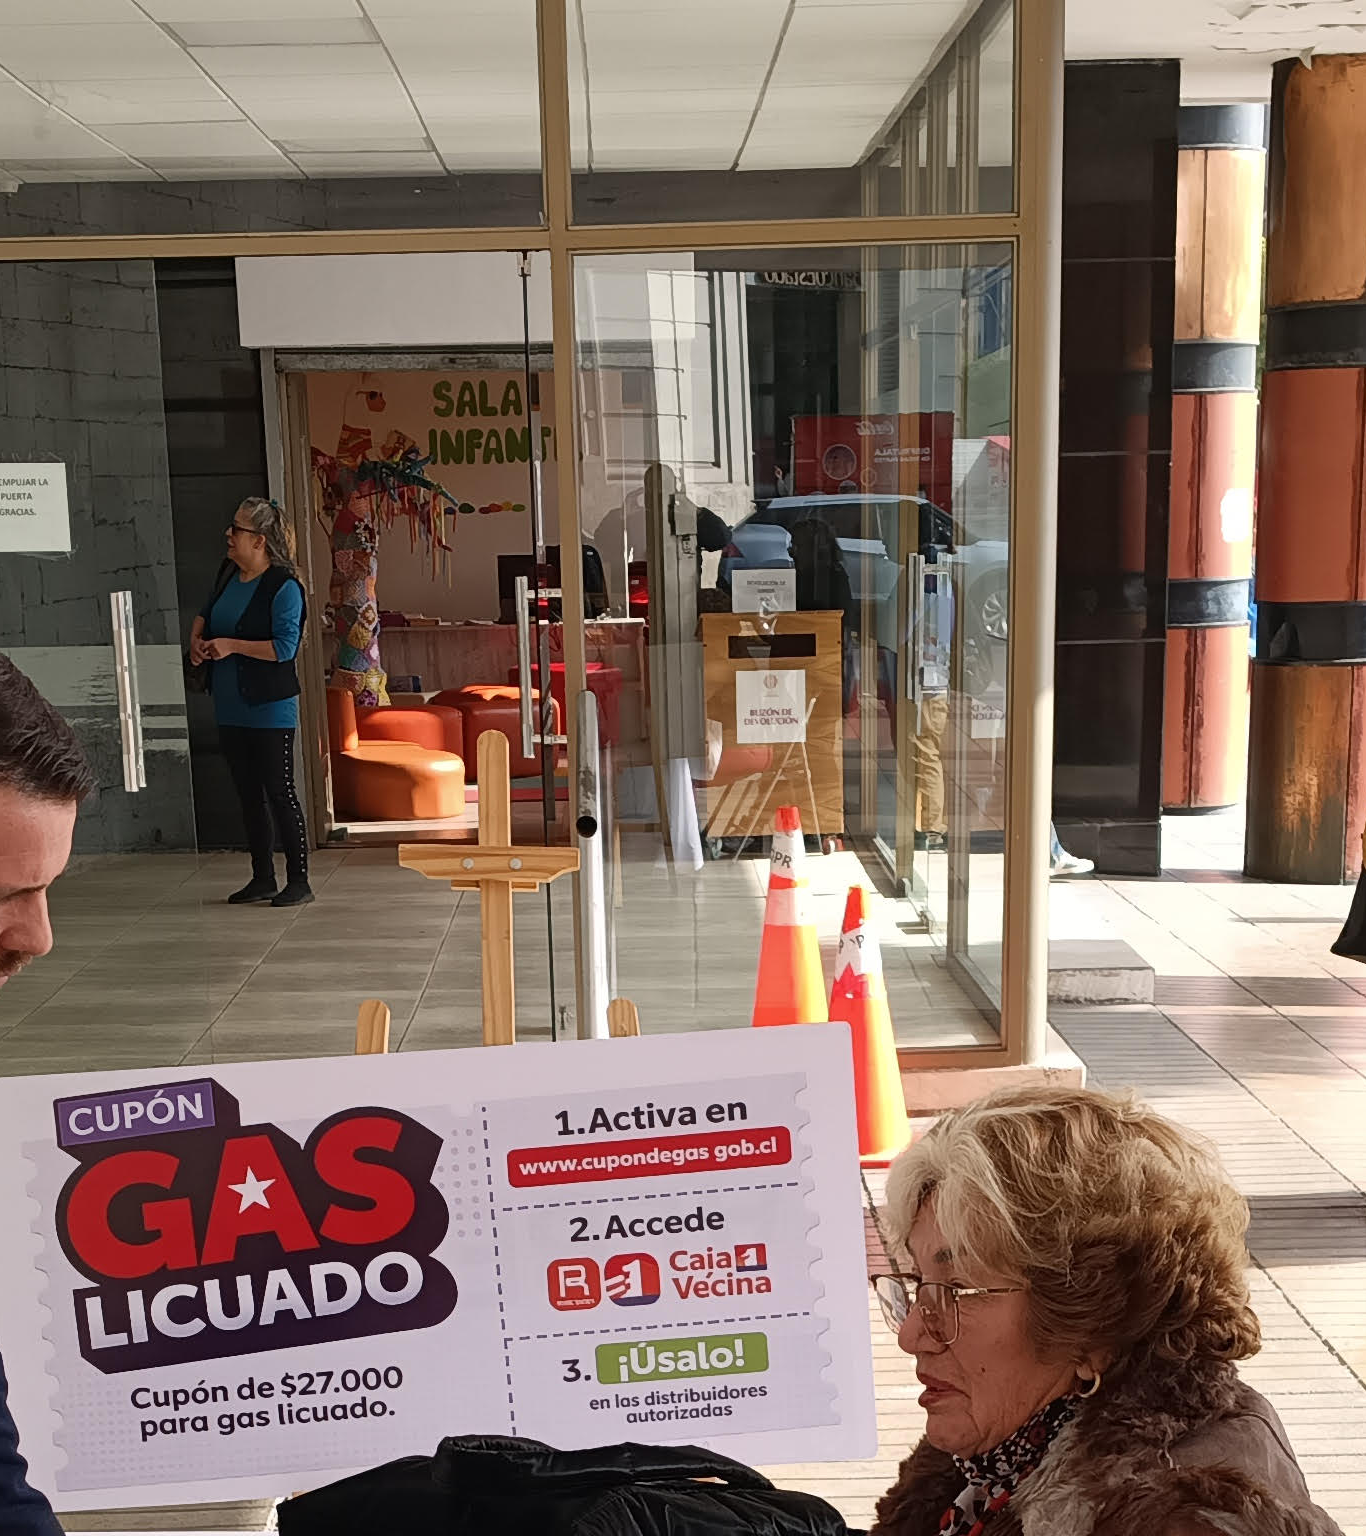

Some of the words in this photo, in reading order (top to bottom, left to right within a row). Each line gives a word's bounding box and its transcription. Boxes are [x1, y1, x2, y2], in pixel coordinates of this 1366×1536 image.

[433, 380, 523, 417] SALA
[1, 492, 33, 500] PUERTA
[39, 478, 49, 486] LA
[68, 1090, 204, 1136] CUPÓN
[705, 1101, 747, 1123] en
[67, 1117, 415, 1278] GAS
[85, 1252, 424, 1350] LICUADO
[562, 1359, 592, 1383] 3.
[618, 1338, 745, 1382] ¡Úsalo!
[131, 1379, 229, 1411] Cupón
[237, 1377, 275, 1400] de
[281, 1366, 404, 1398] $27.000
[589, 1397, 611, 1410] en
[615, 1394, 640, 1408] las
[644, 1385, 768, 1406] distribuidores
[140, 1415, 209, 1442] para
[217, 1410, 270, 1436] gas
[277, 1397, 396, 1425] licuado.
[626, 1403, 733, 1424] autorizadas
